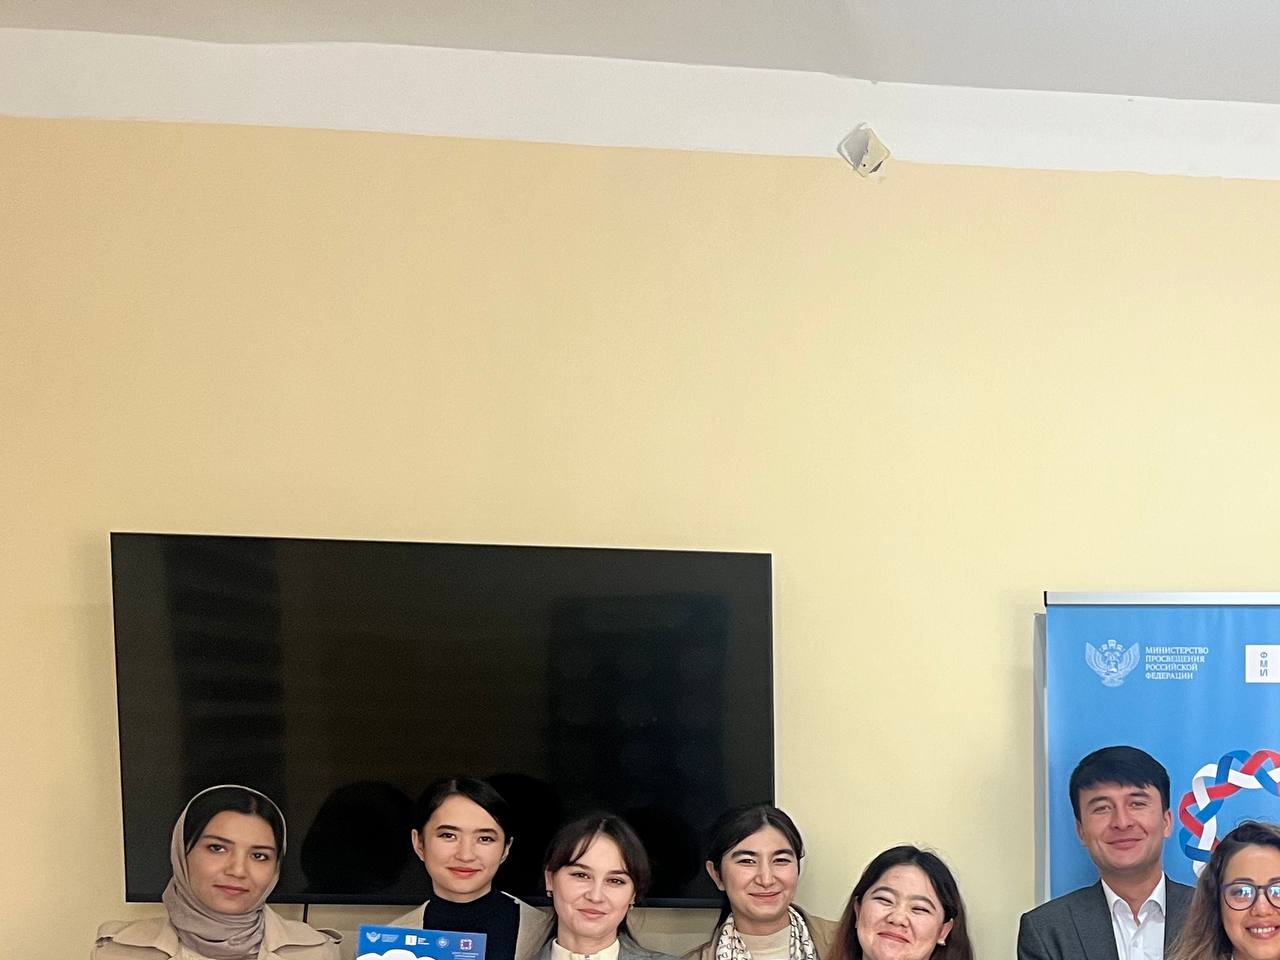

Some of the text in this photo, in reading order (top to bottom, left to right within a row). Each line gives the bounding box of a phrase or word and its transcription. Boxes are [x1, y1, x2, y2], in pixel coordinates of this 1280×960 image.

[1145, 646, 1209, 655] МИНИСТЕРСТВО
[1145, 655, 1206, 663] ПРОСВЕЩЕНИЯ
[1145, 663, 1199, 672] РОССИЙСКОЙ
[1145, 671, 1194, 680] ФЕДЕРАЦИИ
